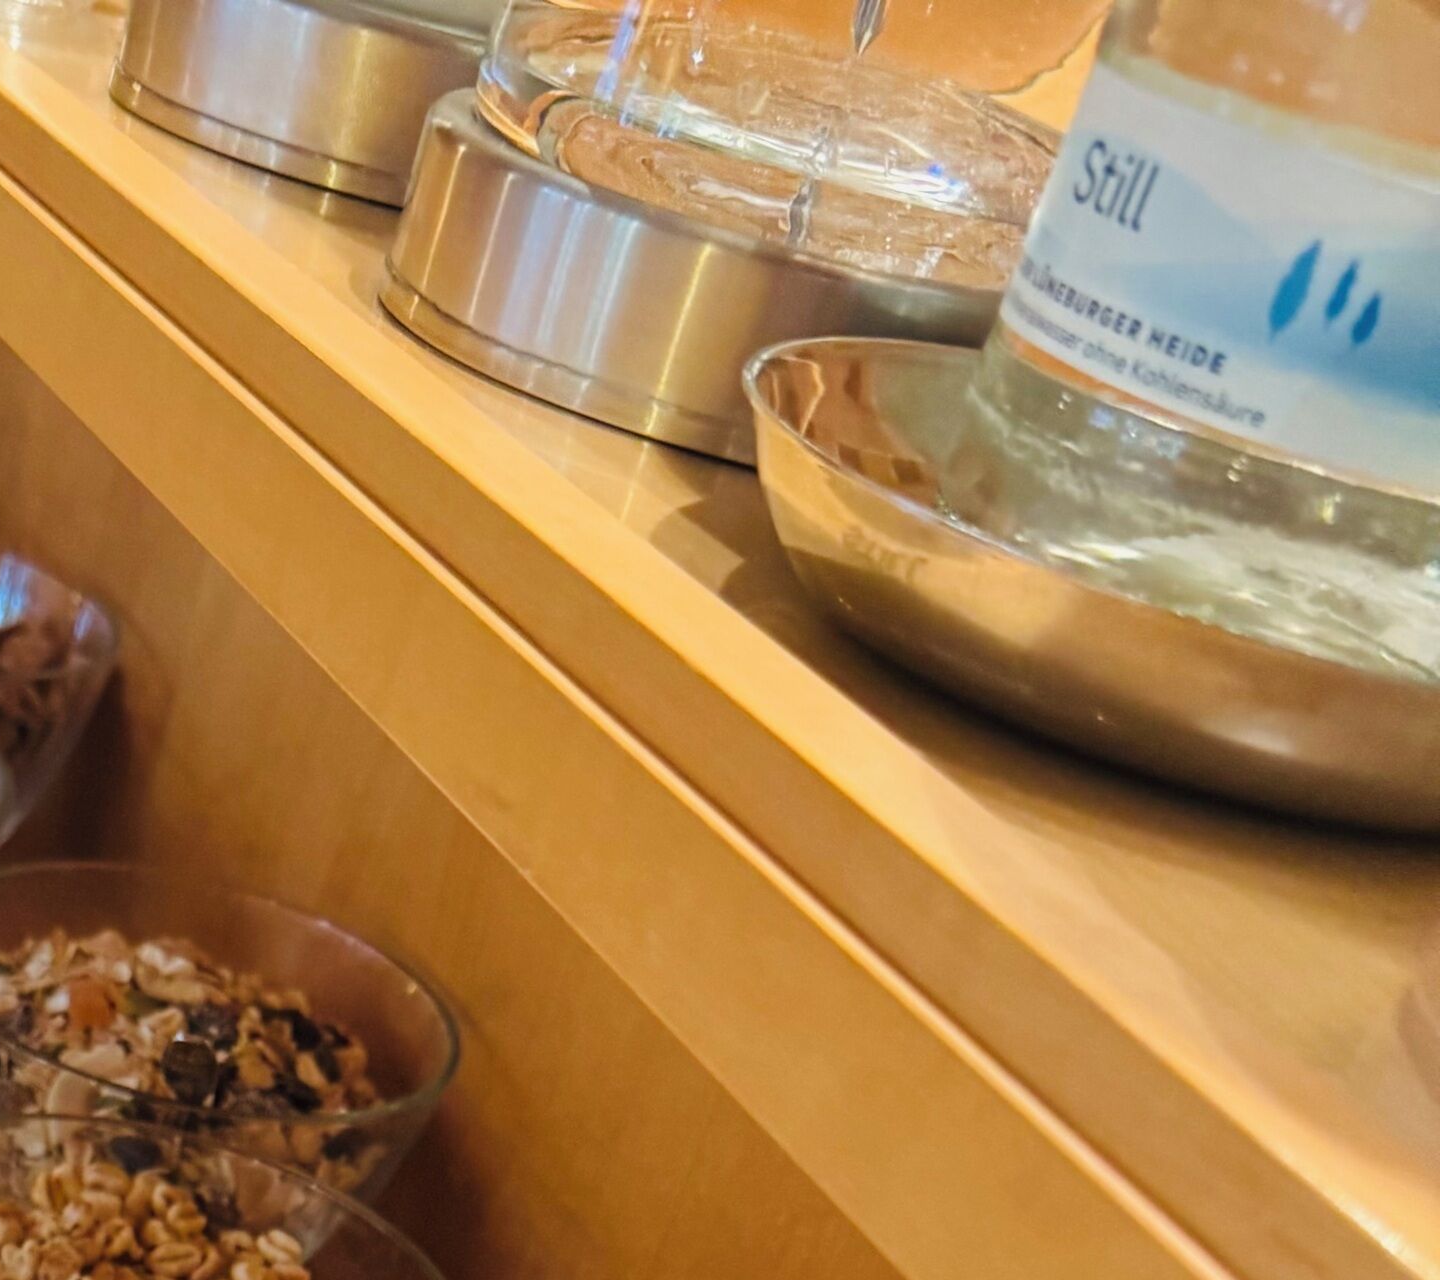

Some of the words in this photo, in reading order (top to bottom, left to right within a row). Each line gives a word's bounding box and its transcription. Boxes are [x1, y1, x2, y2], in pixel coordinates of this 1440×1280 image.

[1072, 138, 1160, 234] Still
[1032, 262, 1144, 340] LÜNEBURGER
[1146, 326, 1228, 377] HEIDE
